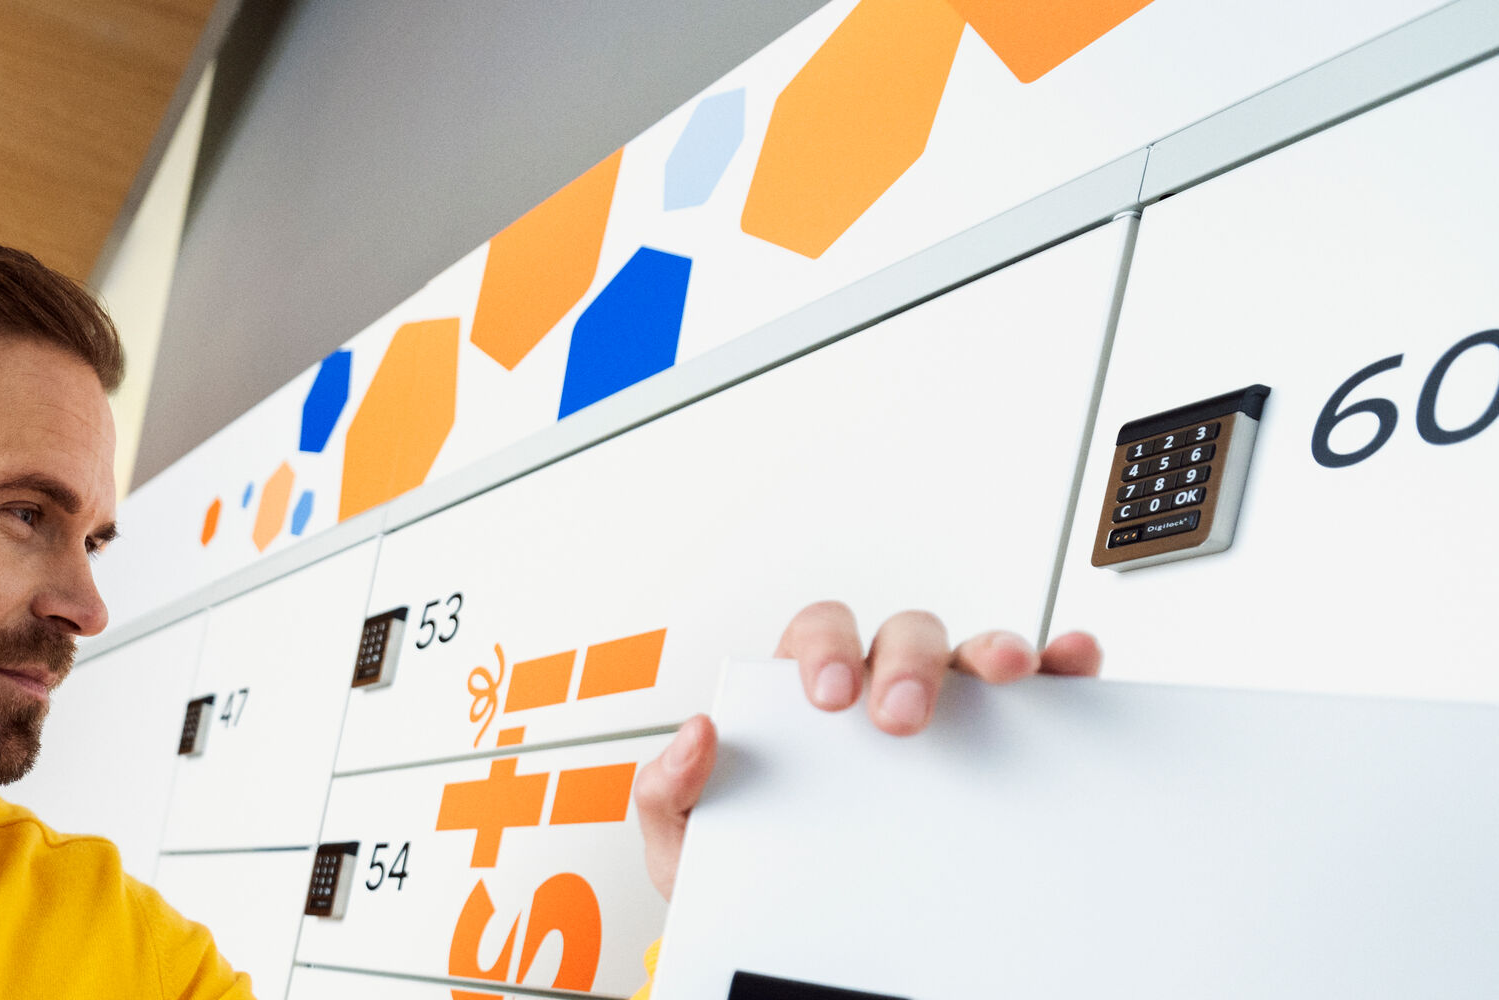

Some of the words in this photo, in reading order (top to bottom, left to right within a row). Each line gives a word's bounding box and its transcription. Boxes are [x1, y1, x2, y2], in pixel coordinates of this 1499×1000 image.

[1311, 328, 1499, 469] 60
[1134, 444, 1143, 458] 1
[1163, 435, 1174, 450] 2
[1195, 426, 1207, 441] 3
[1128, 464, 1139, 477] 4
[1158, 456, 1170, 471] 5
[1190, 447, 1202, 462] 6
[1125, 484, 1136, 499] 7
[1154, 477, 1166, 492] 8
[1185, 468, 1197, 483] 9
[1120, 504, 1131, 518] C
[1149, 498, 1161, 512] 0
[1174, 488, 1199, 505] OK
[415, 592, 463, 650] 53
[219, 687, 249, 728] 47
[365, 842, 411, 891] 54
